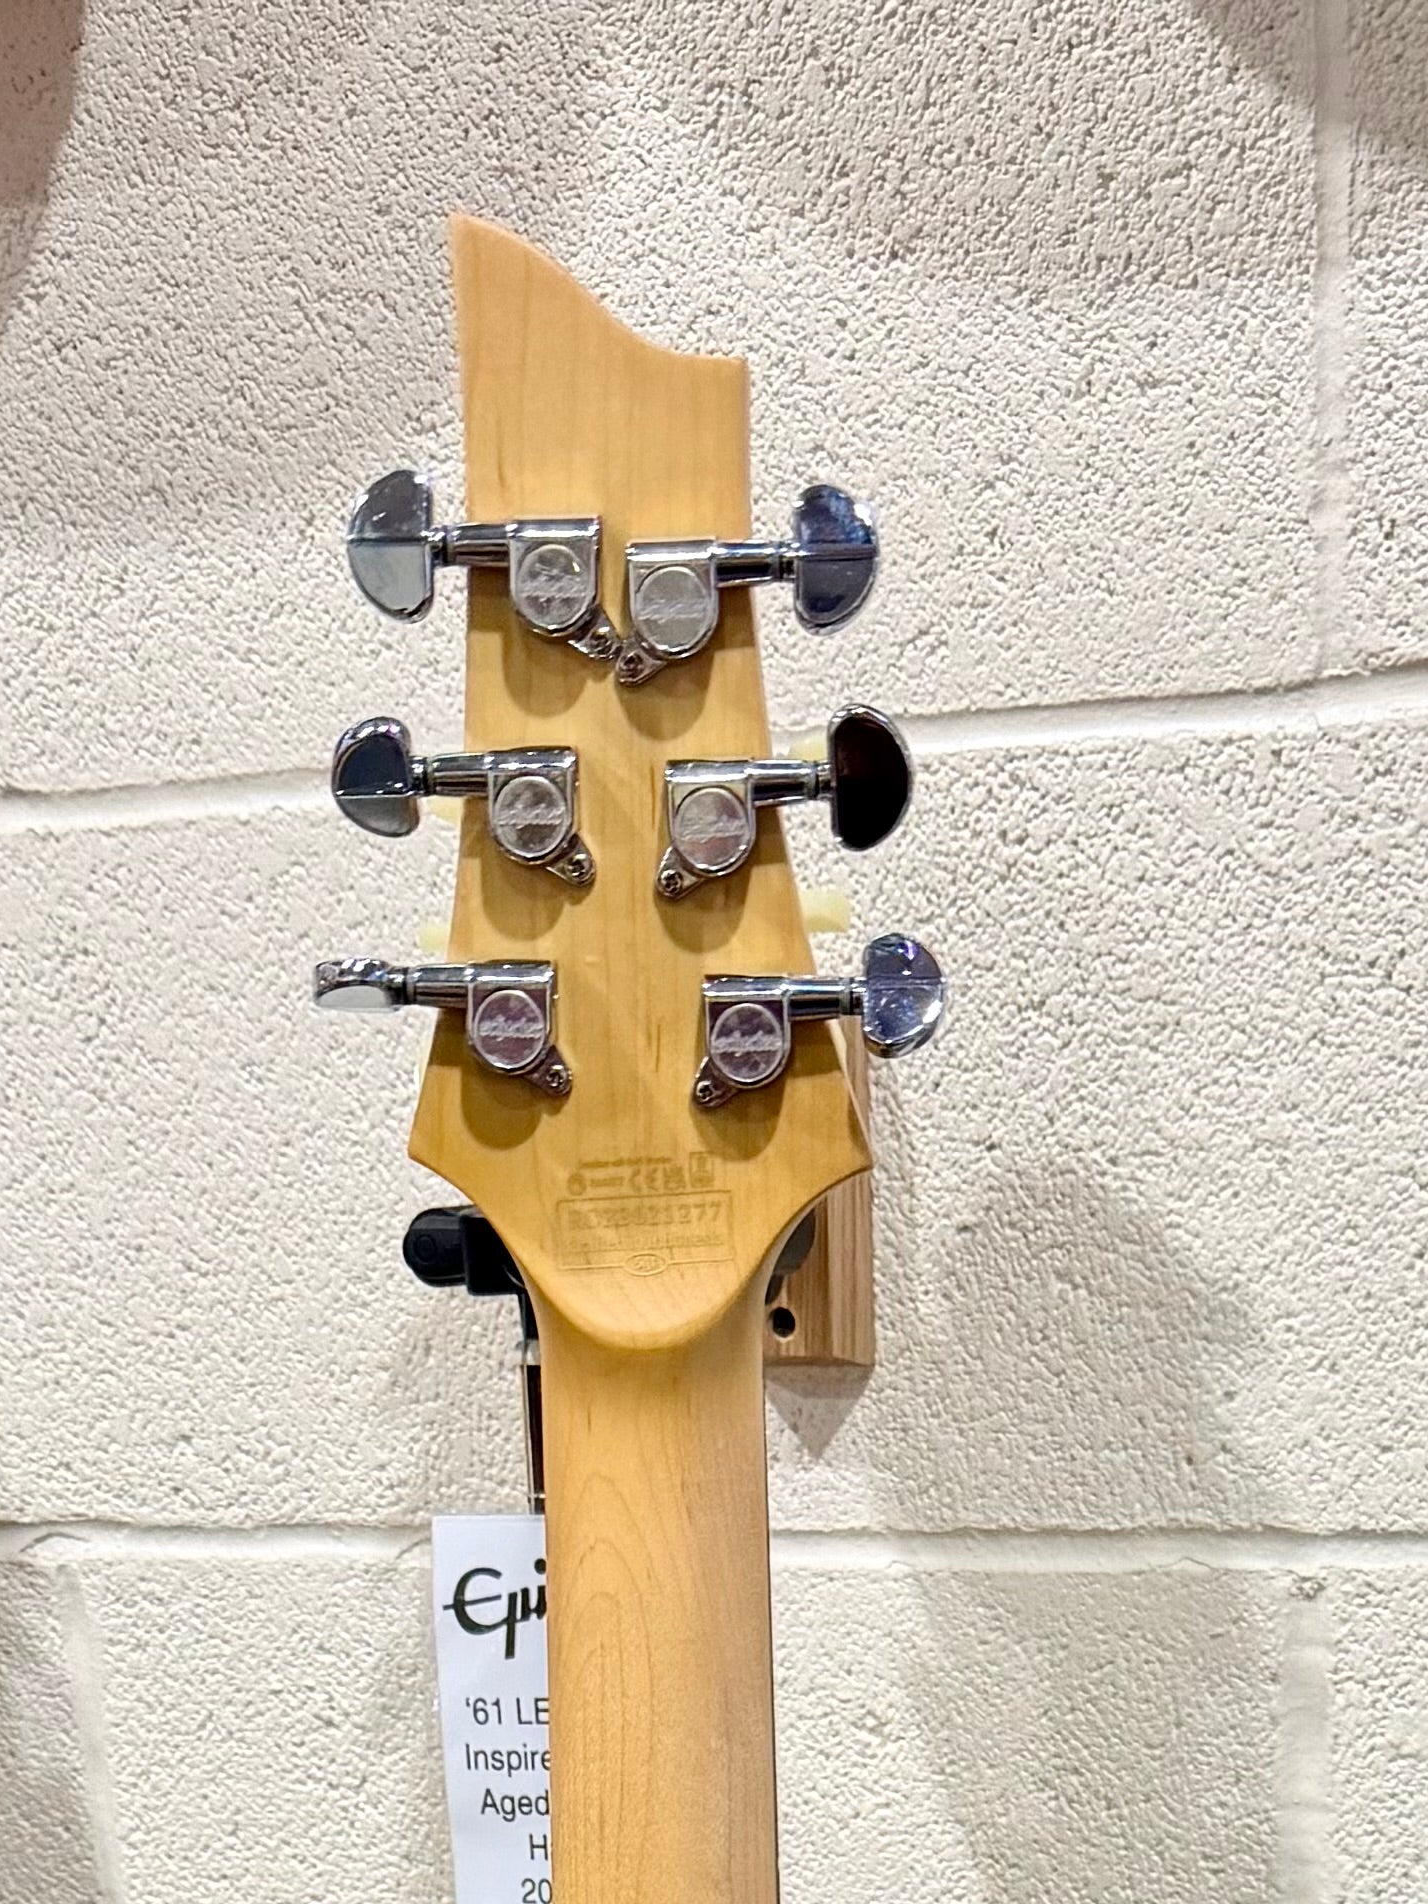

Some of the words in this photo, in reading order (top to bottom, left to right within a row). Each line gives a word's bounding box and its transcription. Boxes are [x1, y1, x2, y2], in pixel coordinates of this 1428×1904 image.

[516, 1697, 550, 1725] LE
[465, 1743, 551, 1778] Inspire
[480, 1788, 550, 1822] Aged
[520, 1878, 553, 1904] 20
